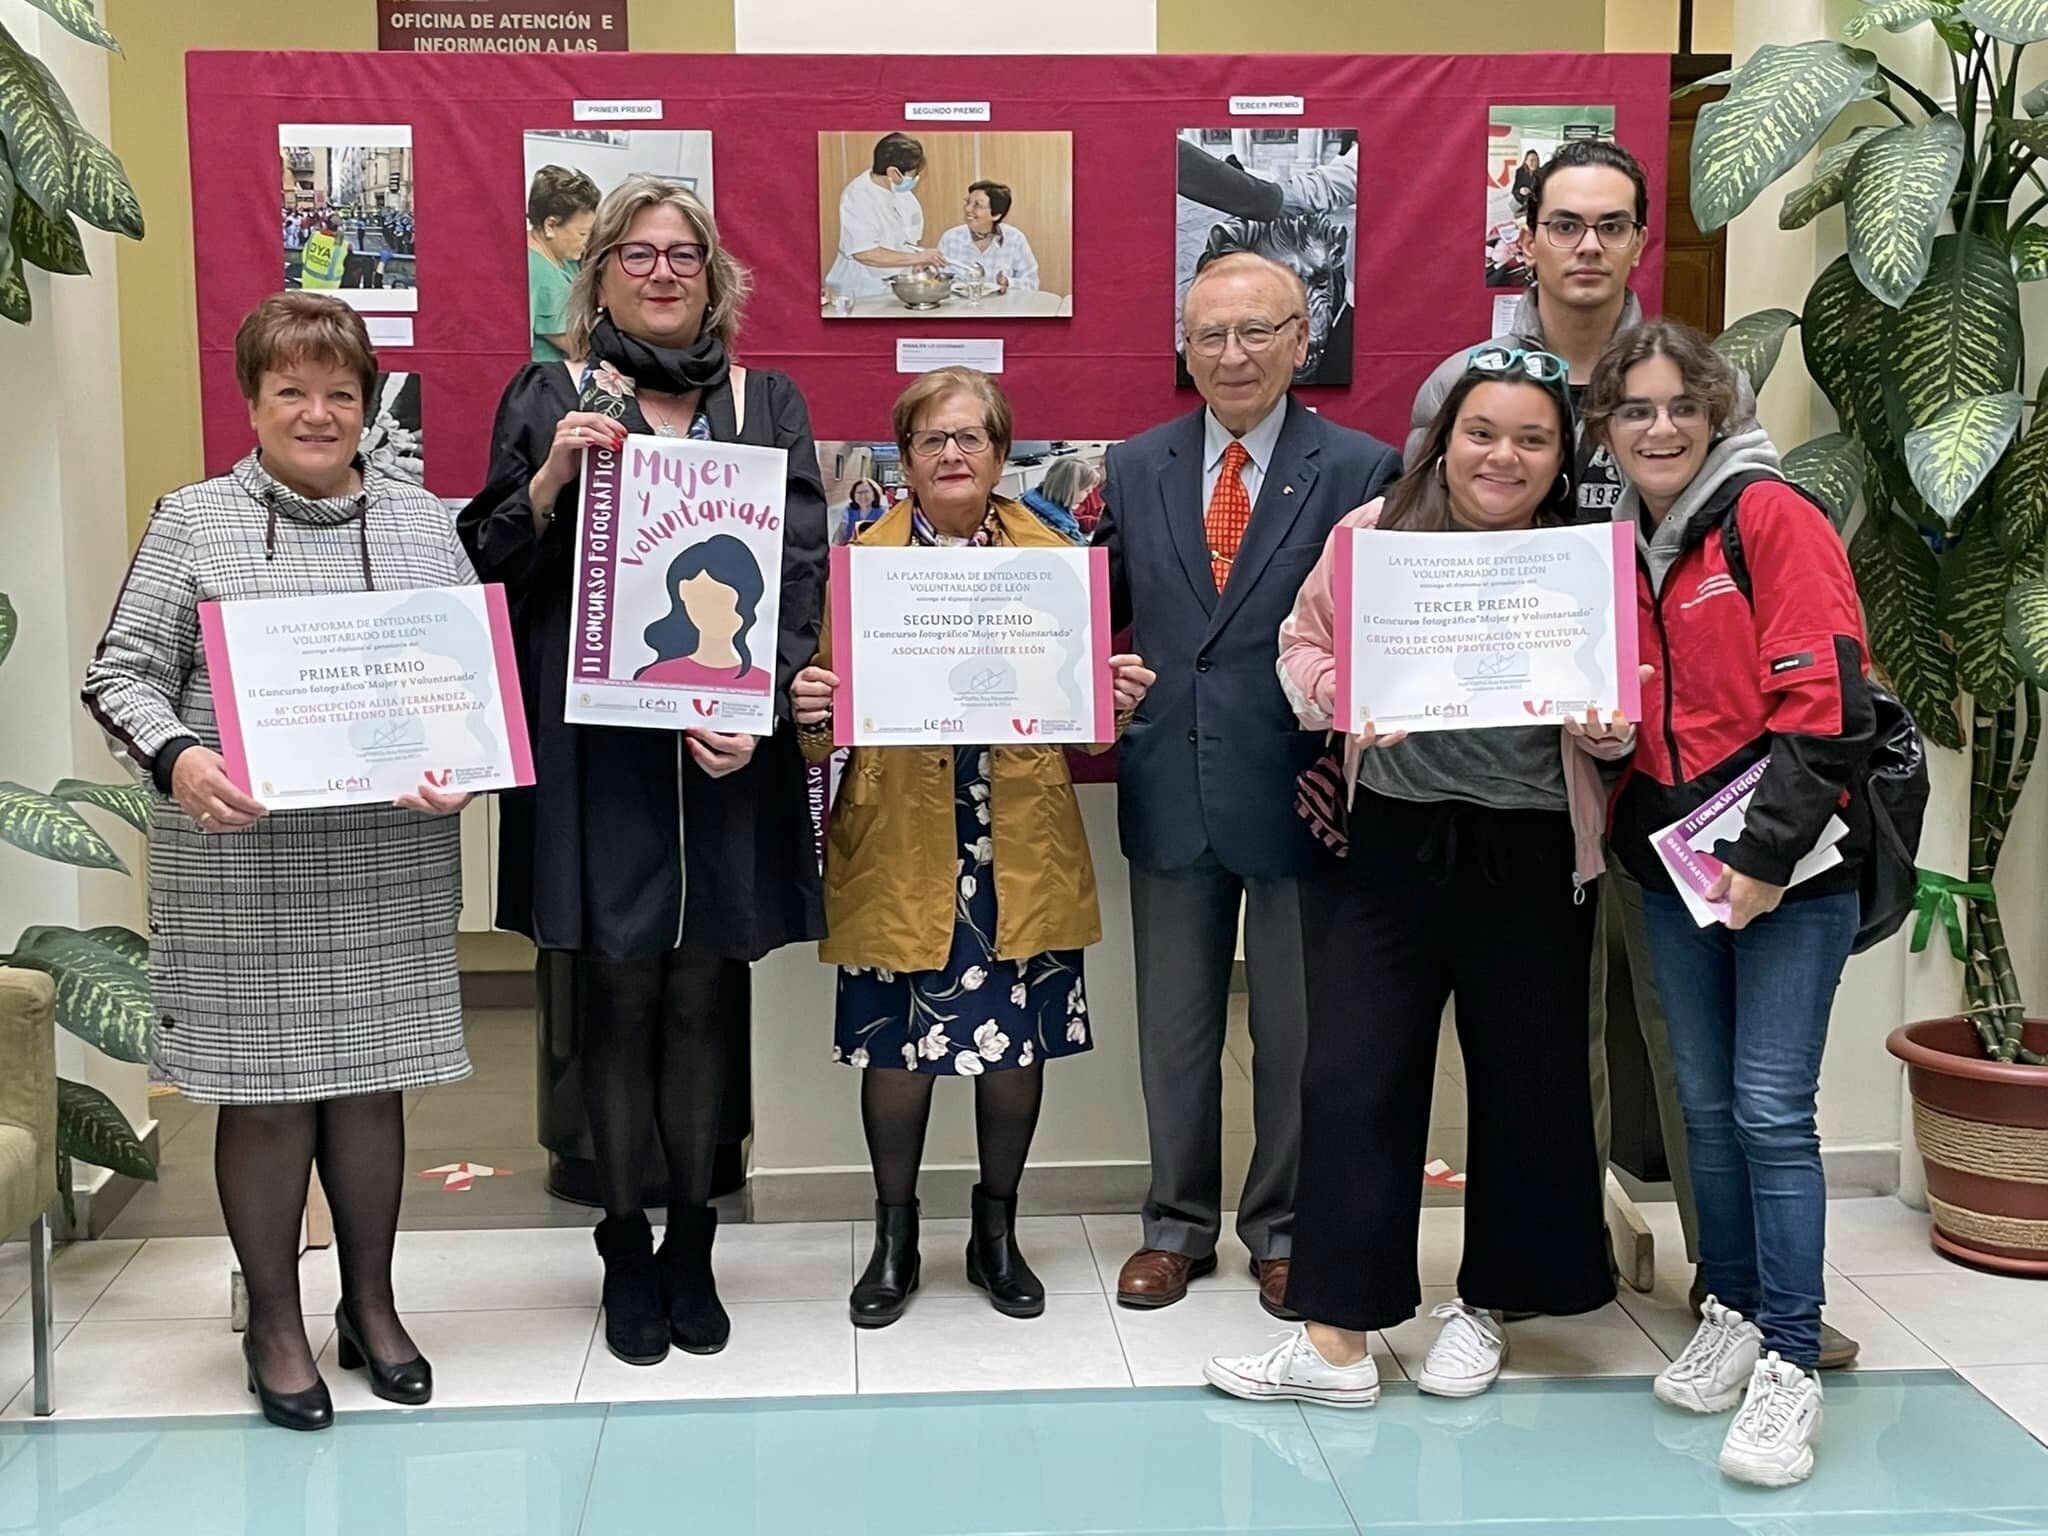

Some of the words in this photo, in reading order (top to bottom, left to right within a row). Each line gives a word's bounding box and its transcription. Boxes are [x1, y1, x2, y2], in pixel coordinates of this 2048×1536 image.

[391, 13, 465, 29] OFICINA
[471, 14, 494, 29] DE
[499, 11, 591, 30] ATENCIÓN
[602, 15, 614, 30] E
[414, 35, 541, 52] INFORMACIÓN
[546, 39, 559, 52] A
[564, 38, 598, 52] LAS
[588, 105, 619, 113] PRIMER
[621, 105, 652, 113] PREMIO
[912, 107, 951, 115] SEGUNDO
[953, 106, 984, 114] PREMIO
[1235, 102, 1267, 110] TERCER
[1269, 101, 1300, 109] PREMIO
[633, 448, 740, 500] Mujer
[620, 497, 780, 566] Voluntariado
[1388, 556, 1401, 566] LA
[1403, 557, 1474, 567] PLATAFORMA
[1477, 557, 1491, 566] DE
[1494, 553, 1555, 565] ENTIDADES
[1557, 552, 1571, 561] DE
[887, 571, 899, 580] LA
[901, 571, 966, 580] PLATAFORMA
[968, 571, 980, 580] DE
[983, 571, 1038, 580] ENTIDADES
[1040, 571, 1052, 580] DE
[1413, 568, 1498, 579] VOLUNTARIADO
[1501, 567, 1514, 577] DE
[1518, 565, 1546, 576] LEÓN
[910, 583, 988, 592] VOLUNTARIADO
[990, 583, 1002, 592] DE
[1005, 581, 1030, 592] LEÓN
[585, 567, 607, 652] CONCURSO
[1414, 601, 1473, 613] TERCER
[1478, 597, 1540, 611] PREMIO
[265, 626, 279, 635] LA
[282, 620, 354, 634] PLATAFORMA
[357, 619, 369, 628] DE
[374, 614, 433, 627] ENTIDADES
[435, 614, 449, 622] DE
[903, 614, 973, 625] SEGUNDO
[977, 614, 1033, 625] PREMIO
[1373, 616, 1420, 626] Concurso
[293, 630, 380, 645] VOLUNTARIADO
[383, 630, 395, 639] DE
[398, 627, 426, 638] LEÓN
[873, 630, 917, 638] Concurso
[1414, 635, 1429, 644] DE
[1431, 630, 1522, 644] COMUNICACIÓN
[1525, 630, 1531, 639] Y
[892, 645, 956, 656] ASOCIACIÓN
[1018, 645, 1046, 655] LEÓN
[1384, 644, 1453, 656] ASOCIACIÓN
[1456, 641, 1515, 653] PROYECTO
[1517, 638, 1572, 650] CONVIVO
[299, 665, 361, 681] PRIMER
[364, 660, 425, 676] PREMIO
[259, 686, 308, 698] Concurso
[256, 713, 327, 728] ASOCIACIÓN
[389, 707, 404, 717] DE
[406, 706, 420, 716] LA
[422, 701, 486, 714] ESPERANZA
[292, 700, 366, 715] CONCEPCIÓN
